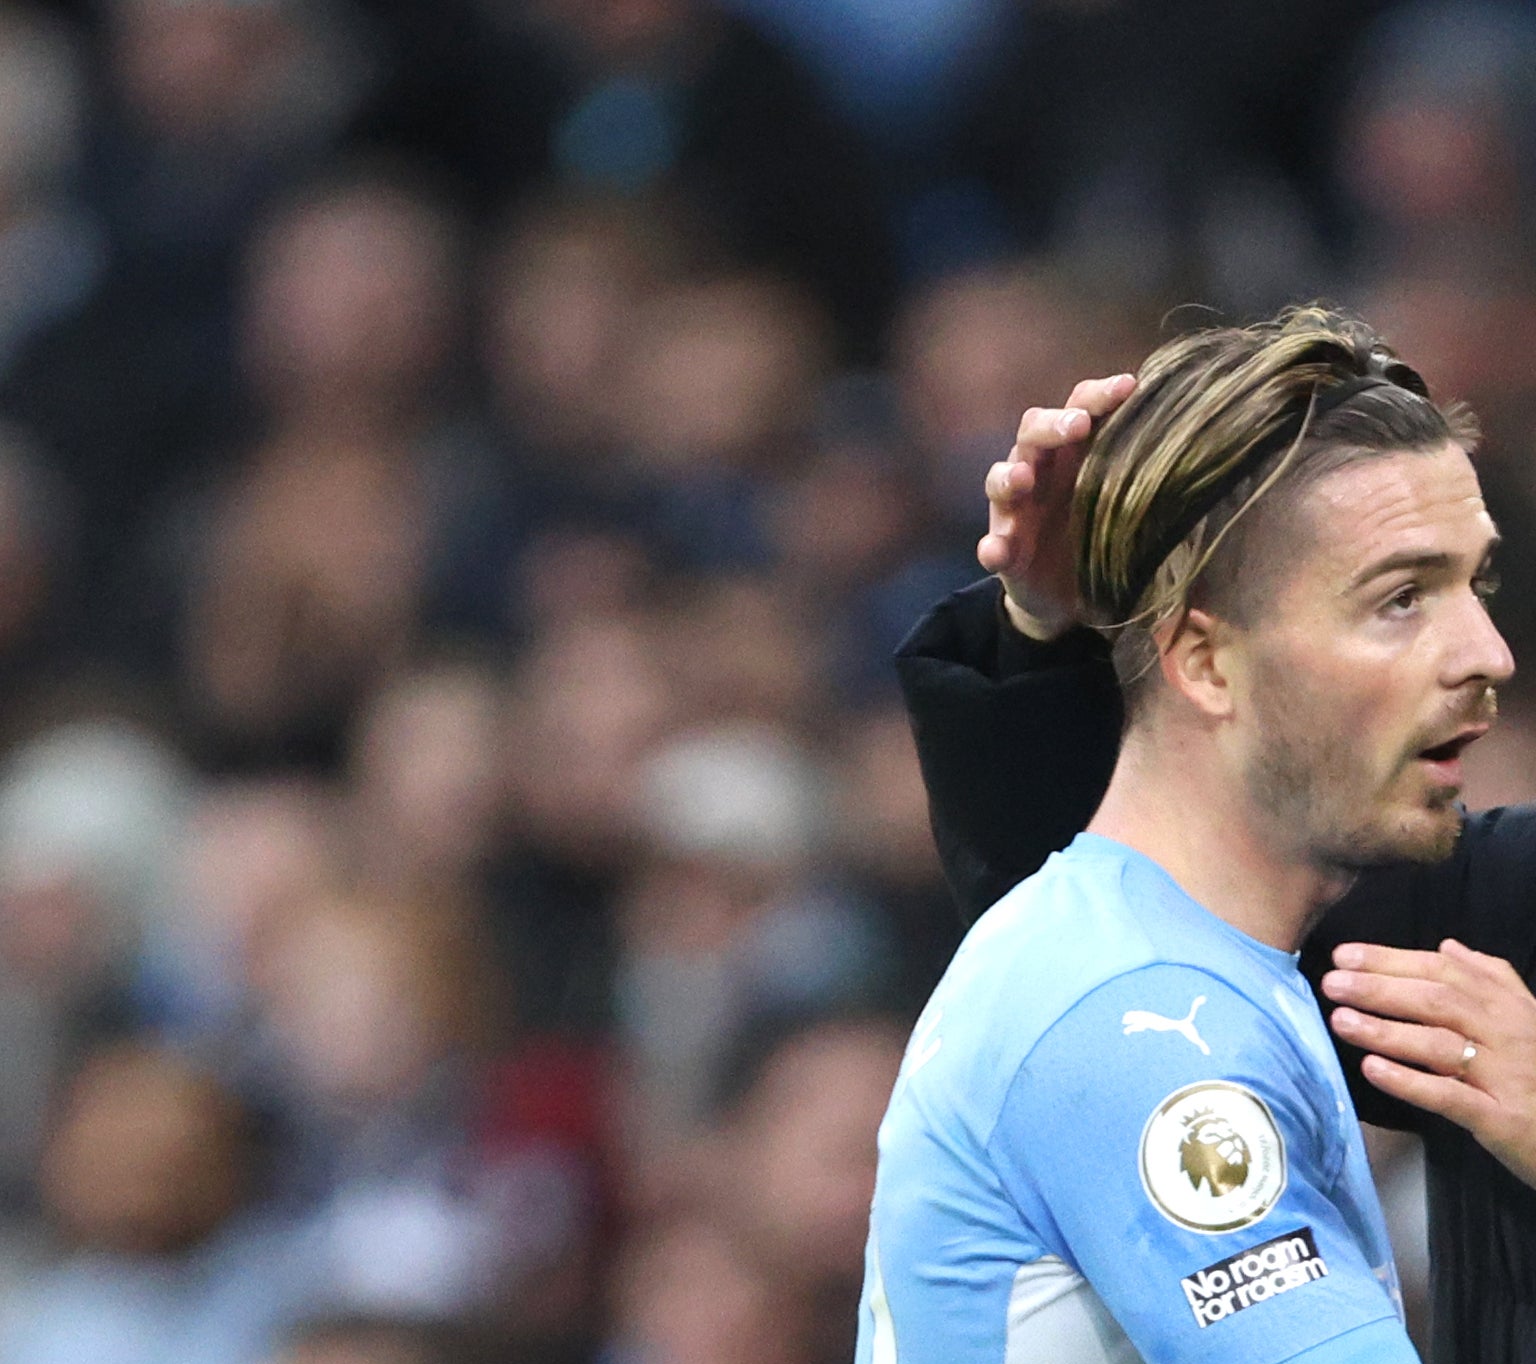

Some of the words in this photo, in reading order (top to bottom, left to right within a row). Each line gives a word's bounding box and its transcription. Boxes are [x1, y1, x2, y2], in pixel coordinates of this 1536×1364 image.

[1181, 1266, 1231, 1302] No
[1229, 1236, 1310, 1284] room
[1237, 1257, 1329, 1308] racism
